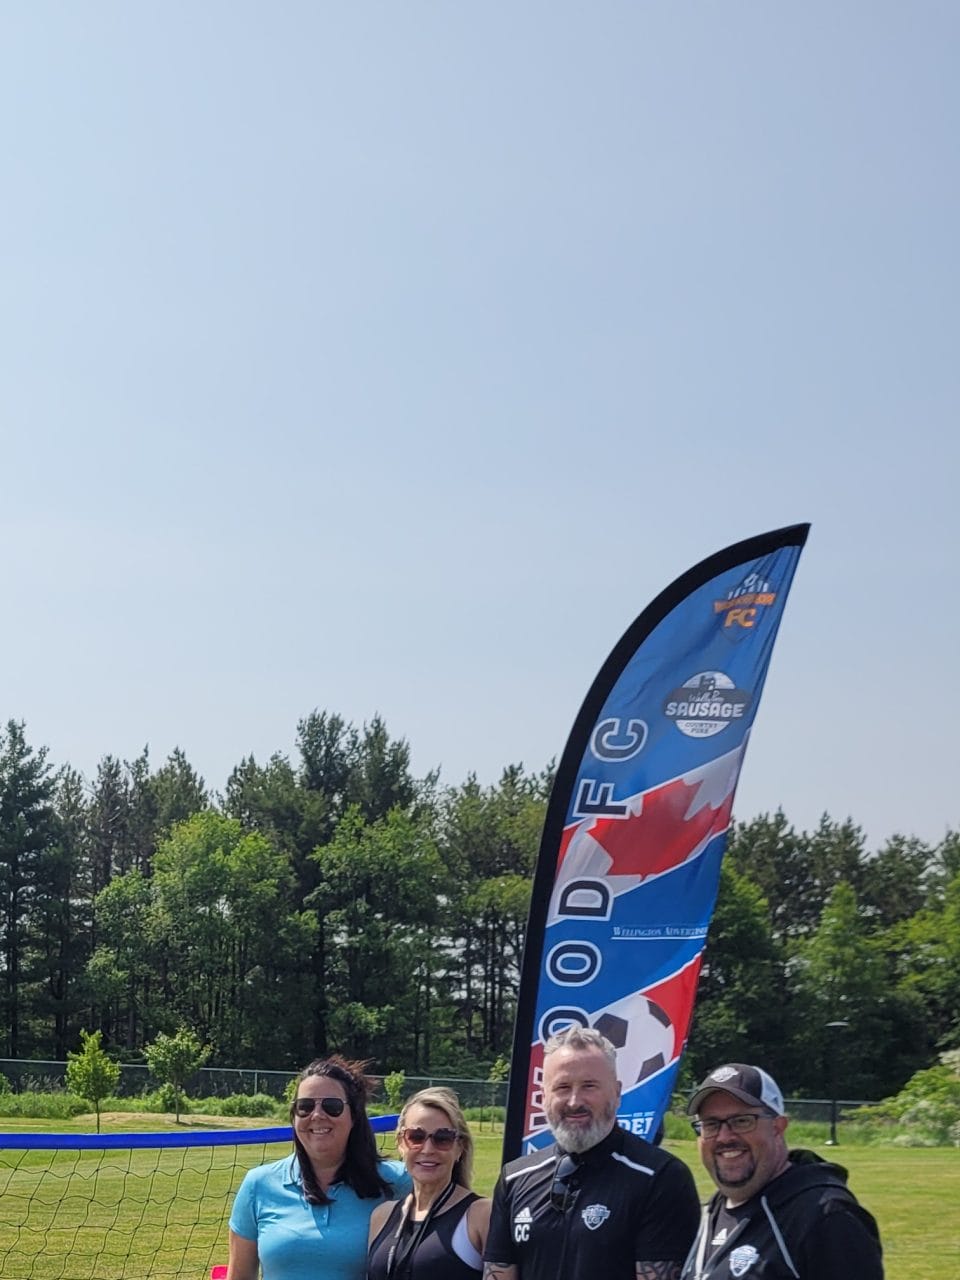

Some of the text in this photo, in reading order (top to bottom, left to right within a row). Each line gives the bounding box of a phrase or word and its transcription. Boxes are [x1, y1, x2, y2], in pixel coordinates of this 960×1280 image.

[724, 608, 757, 628] FC
[665, 701, 745, 718] SAUSAGE
[515, 1223, 530, 1242] CC
